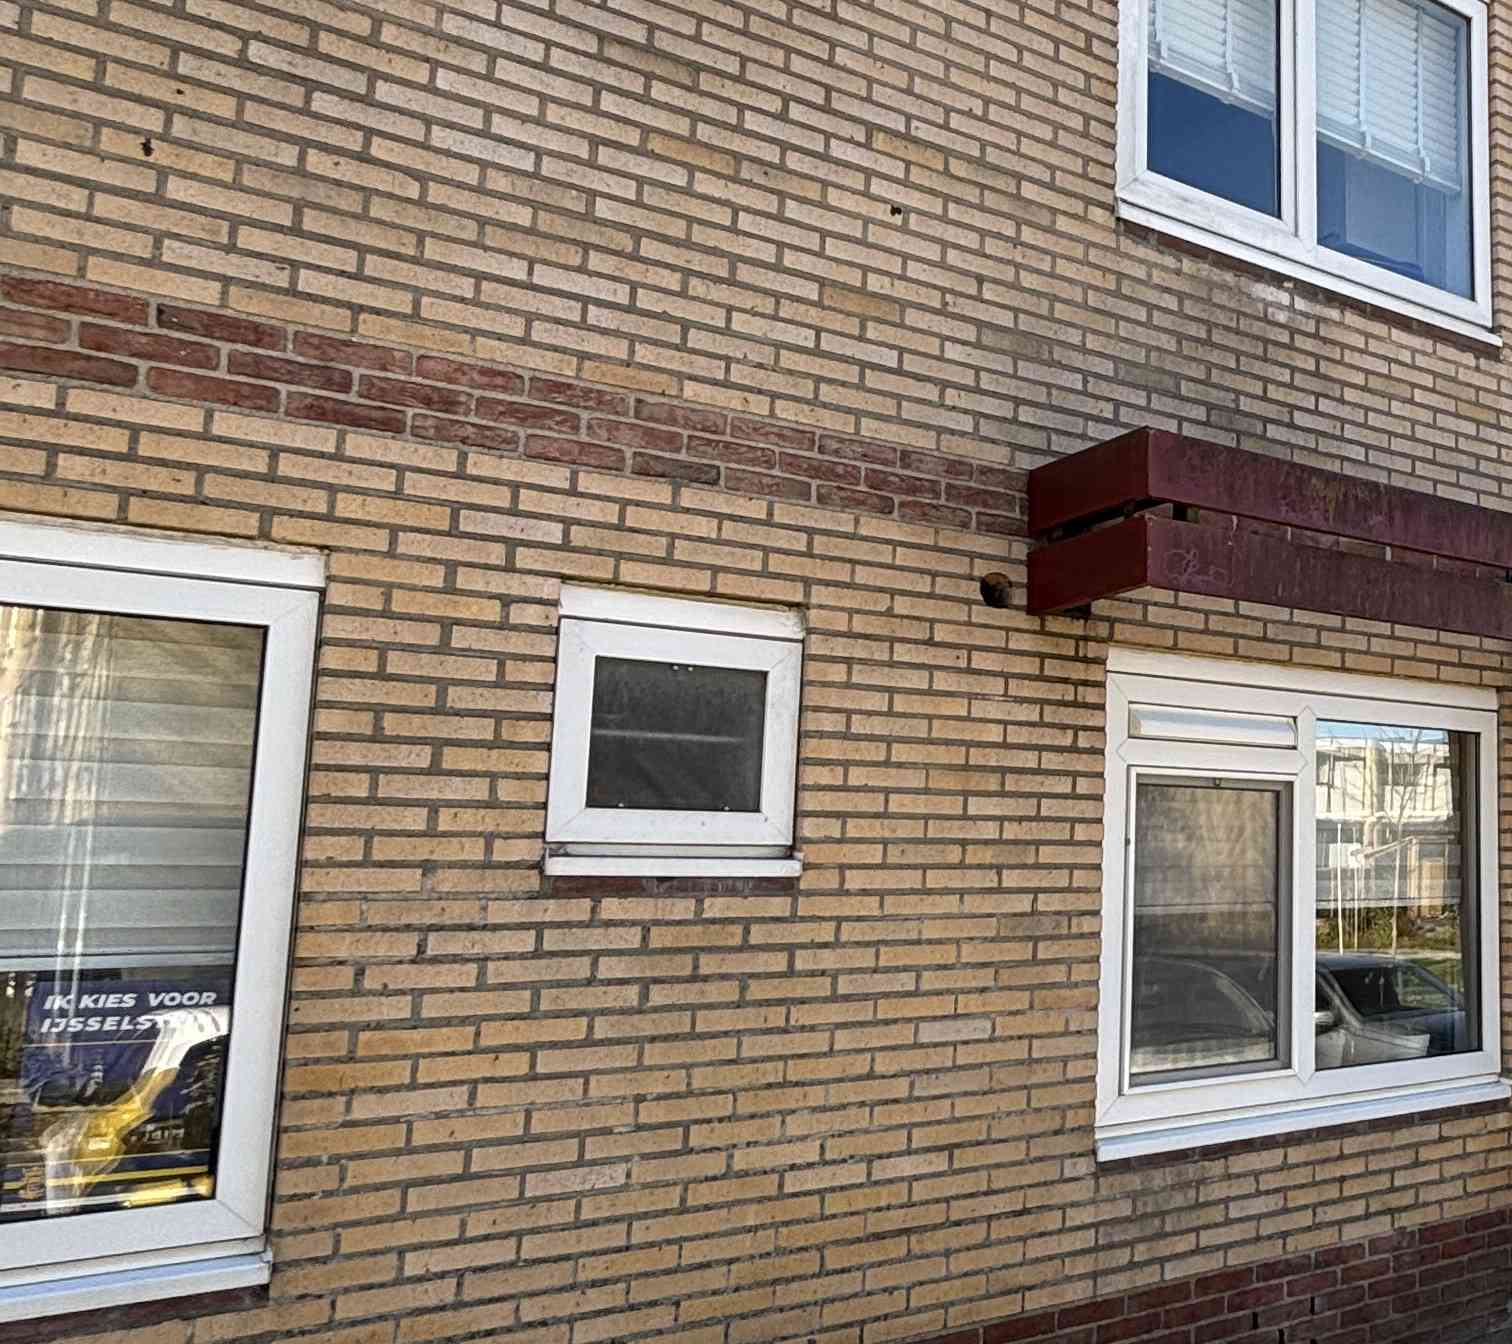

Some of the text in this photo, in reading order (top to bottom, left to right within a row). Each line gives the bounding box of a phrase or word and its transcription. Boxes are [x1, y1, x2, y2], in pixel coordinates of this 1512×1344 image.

[43, 992, 217, 1009] IK KIES VOOR
